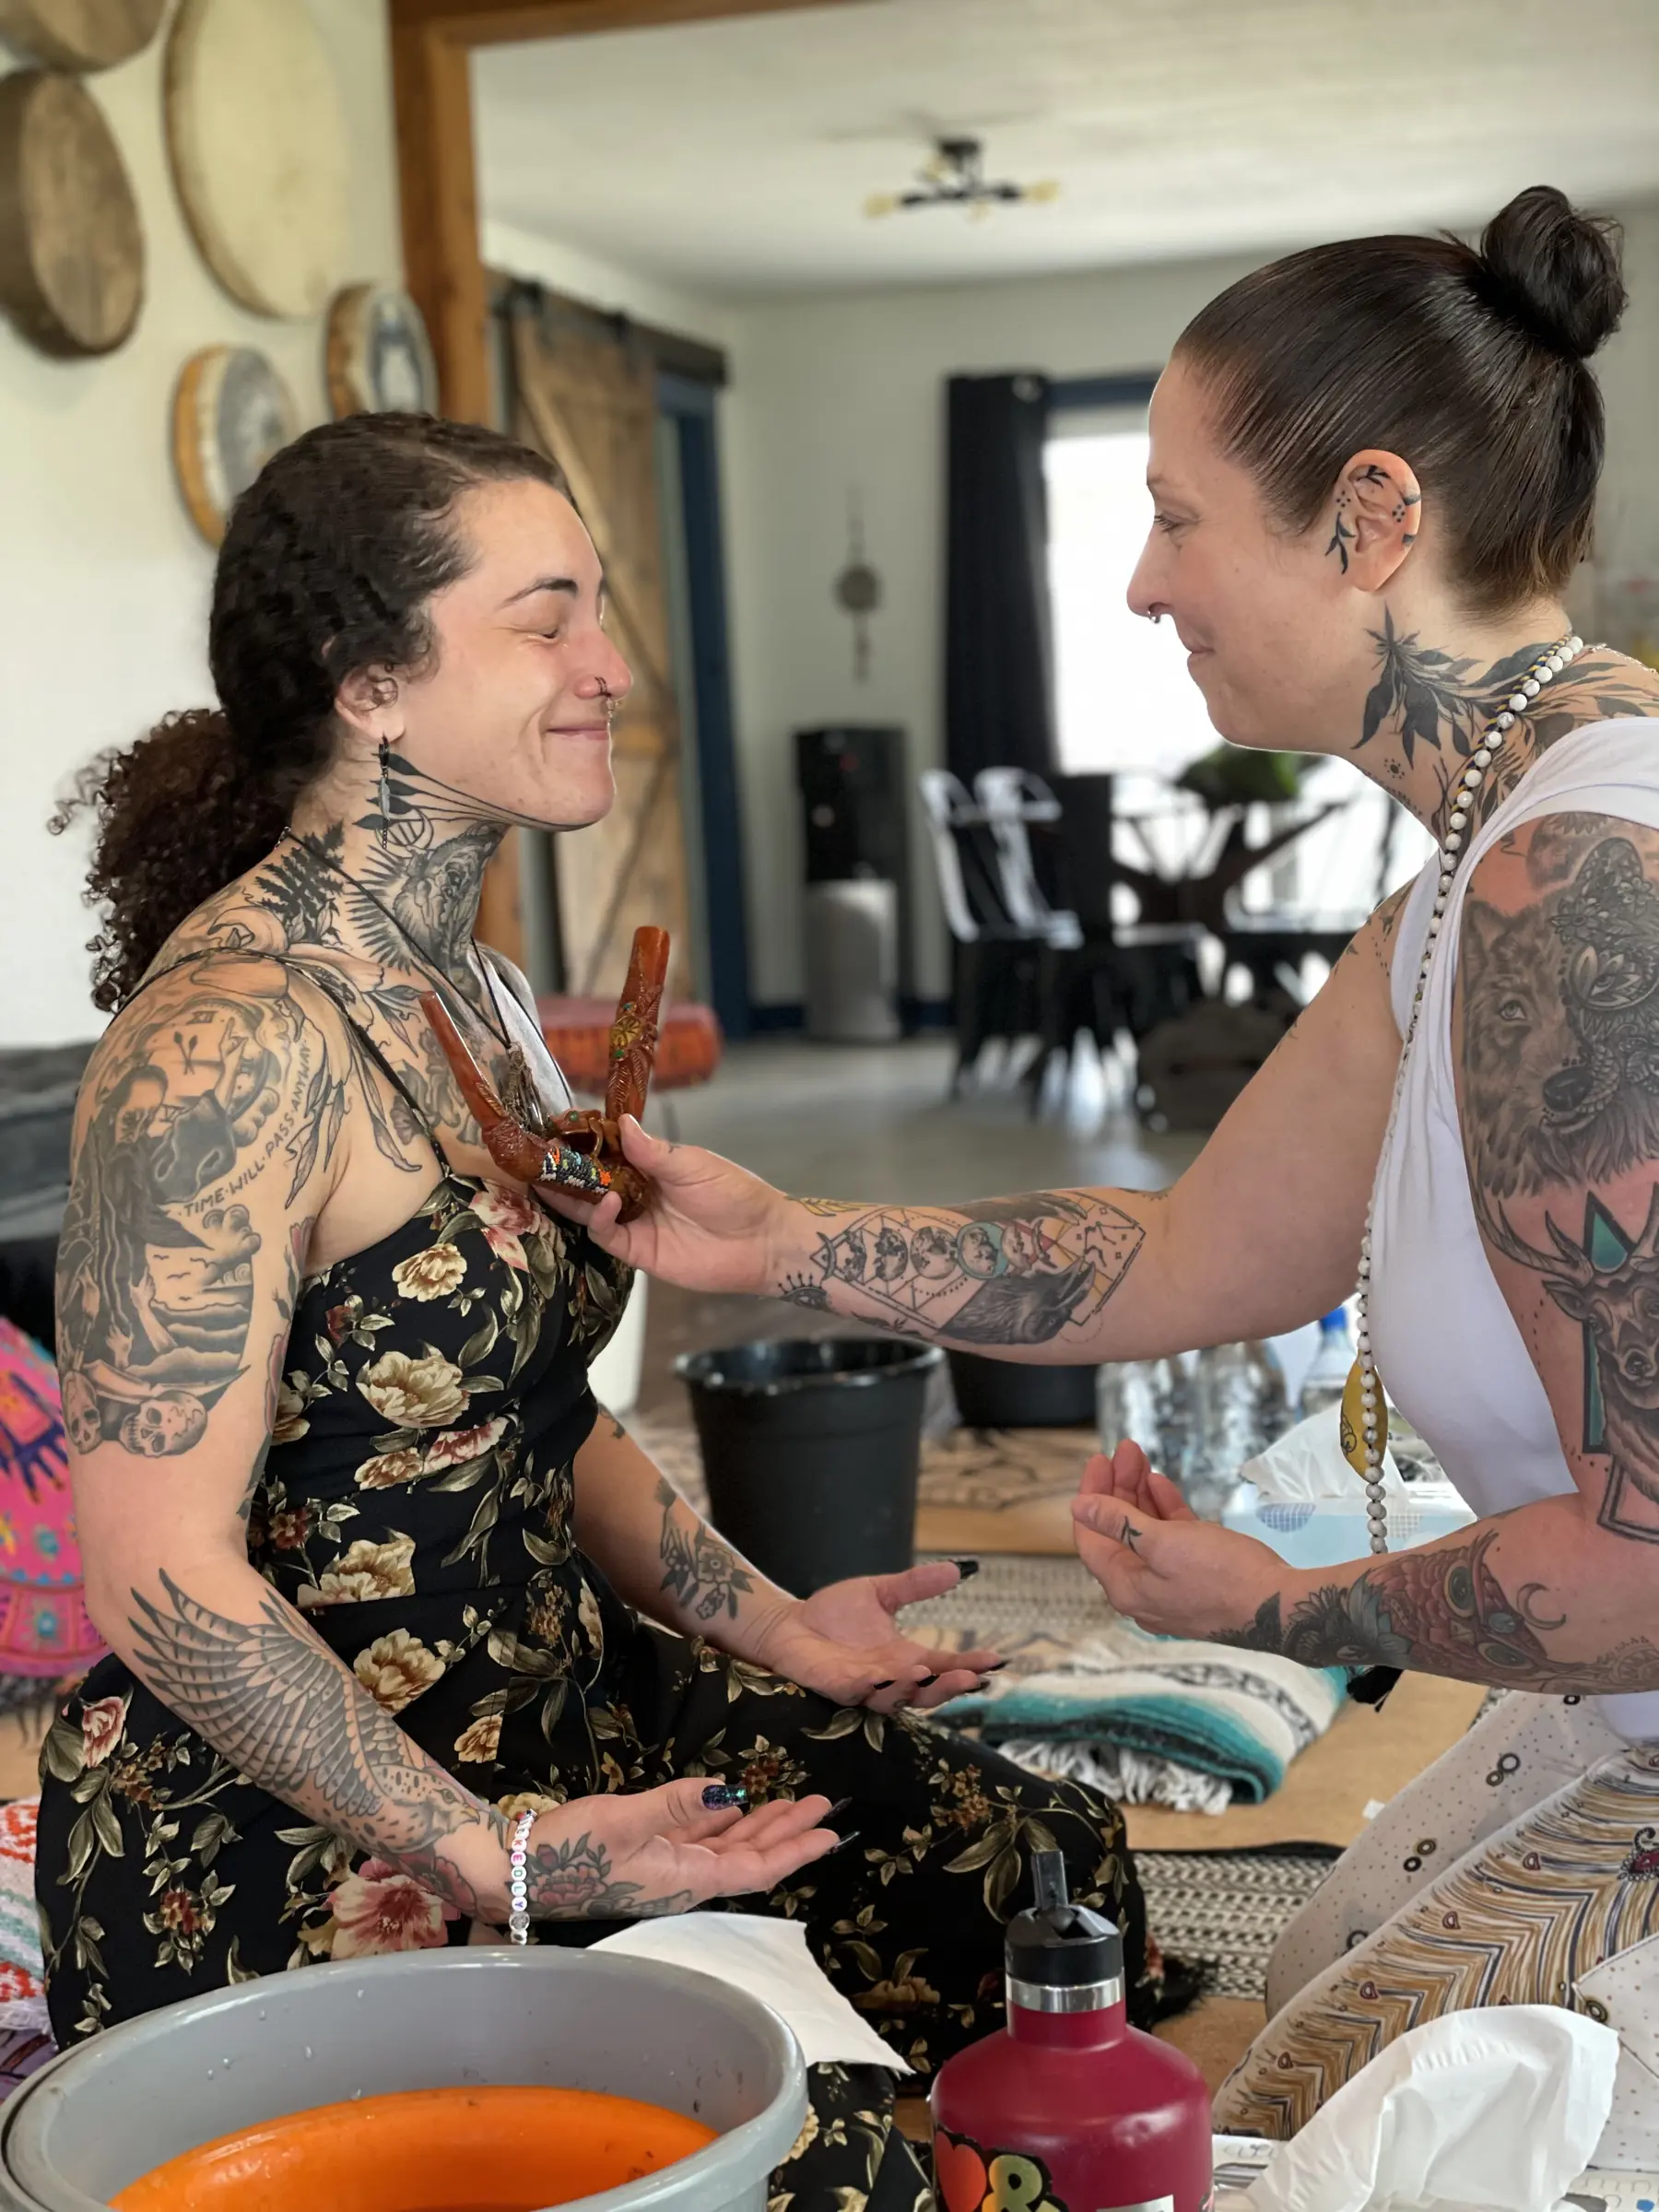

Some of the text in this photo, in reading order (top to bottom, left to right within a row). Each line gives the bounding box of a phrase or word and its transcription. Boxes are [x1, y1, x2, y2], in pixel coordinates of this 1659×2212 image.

[183, 1045, 312, 1217] TIME WILL PASS ANYWAY
